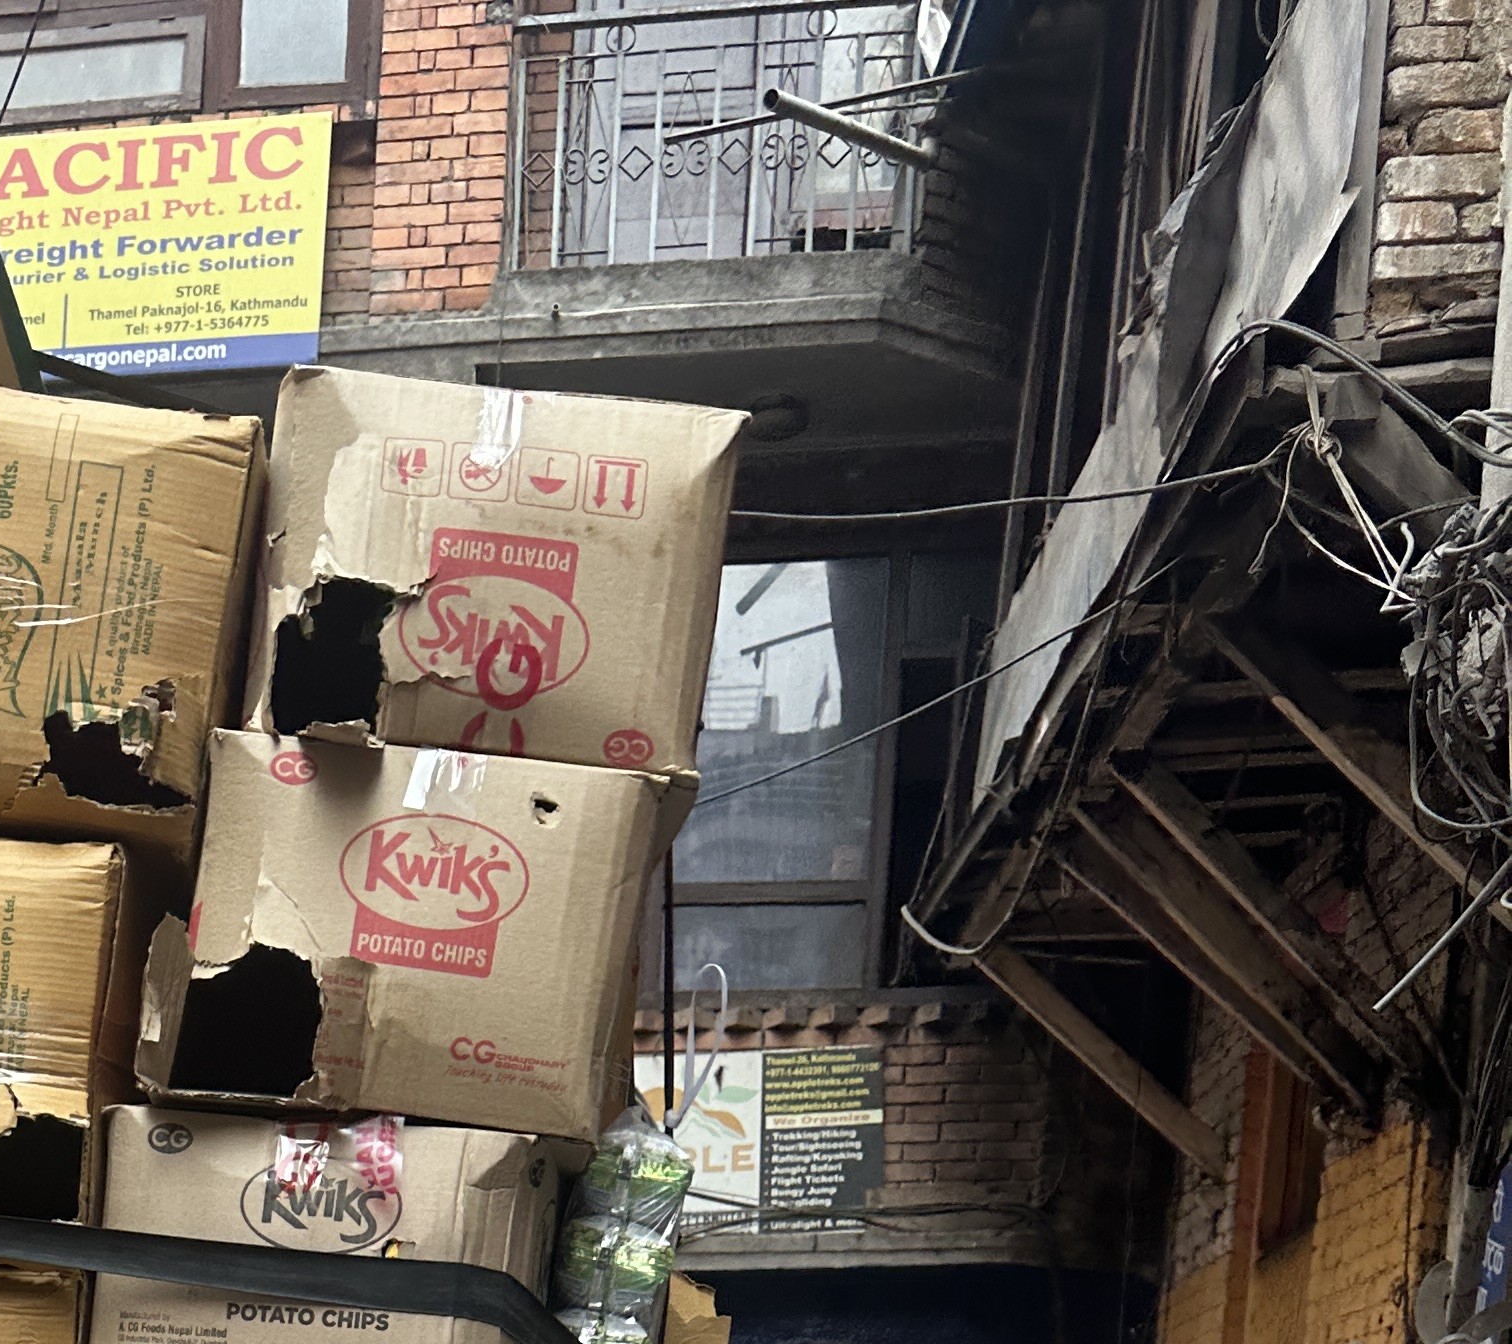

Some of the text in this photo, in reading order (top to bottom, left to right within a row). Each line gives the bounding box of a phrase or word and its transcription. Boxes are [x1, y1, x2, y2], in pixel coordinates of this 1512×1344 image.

[61, 197, 150, 228] Nepal
[163, 197, 224, 219] Pvt.
[239, 190, 303, 214] Ltd.
[3, 225, 304, 268] reight Forwarder
[7, 253, 295, 286] urier & Logistic Solution
[175, 283, 221, 299] STORE
[88, 295, 309, 322] Thamel Paknajol-16, Kathmandu
[124, 313, 270, 336] Tel: +977-1-5364775
[85, 490, 109, 574] Munch
[437, 535, 573, 574] POTATO CHIPS
[417, 584, 565, 683] Kwik's
[606, 736, 650, 760] CG
[273, 757, 316, 778] CG
[363, 827, 512, 923] Kwik's
[356, 932, 488, 969] POTATO CHIPS
[449, 1036, 569, 1070] CG CHAUDHARY
[772, 1113, 871, 1127] We Organize
[150, 1128, 190, 1148] CG
[770, 1173, 845, 1187] Flight Tickets
[260, 1168, 388, 1245] Kwik's
[226, 1302, 390, 1332] POTATO CHIPS
